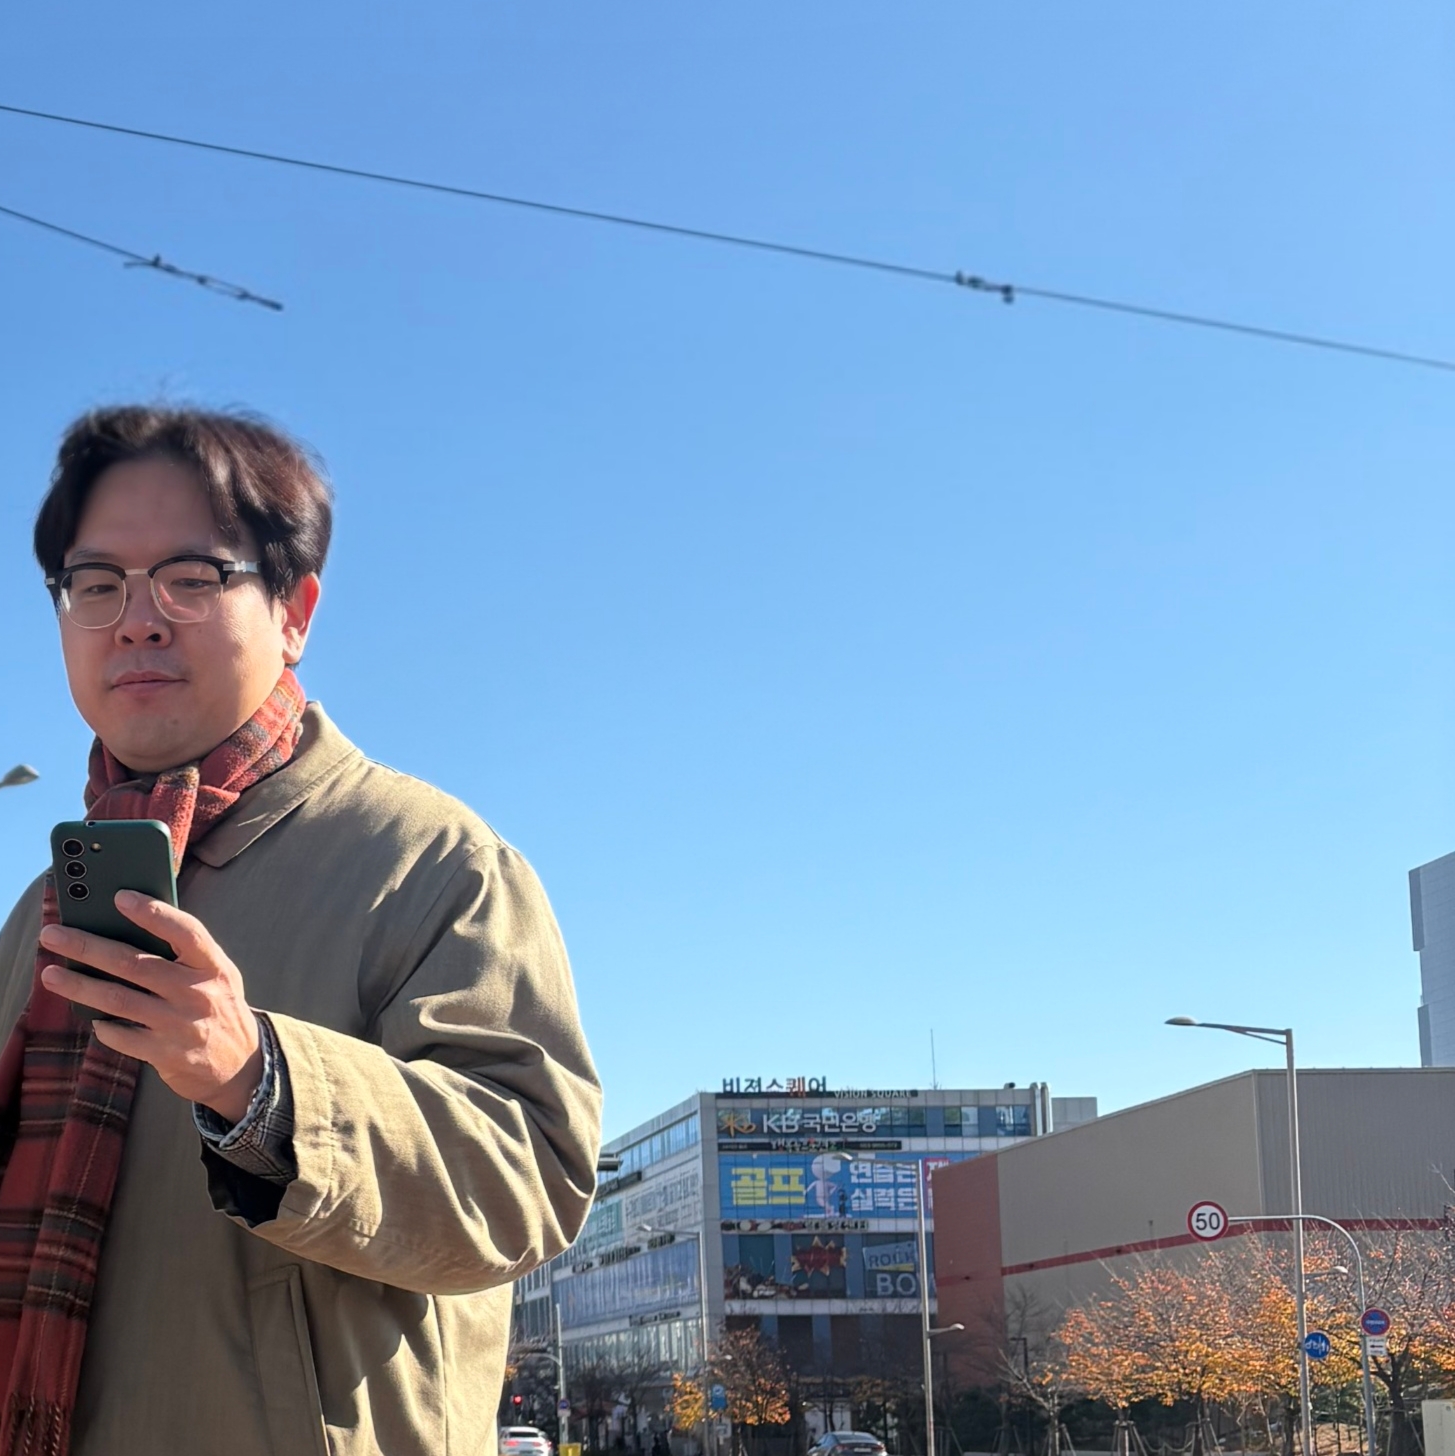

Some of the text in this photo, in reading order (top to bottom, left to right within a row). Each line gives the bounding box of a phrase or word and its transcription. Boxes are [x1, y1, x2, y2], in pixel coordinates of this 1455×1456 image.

[871, 1090, 911, 1099] SQUARE
[731, 1167, 806, 1205] 골프
[1195, 1212, 1220, 1231] 50
